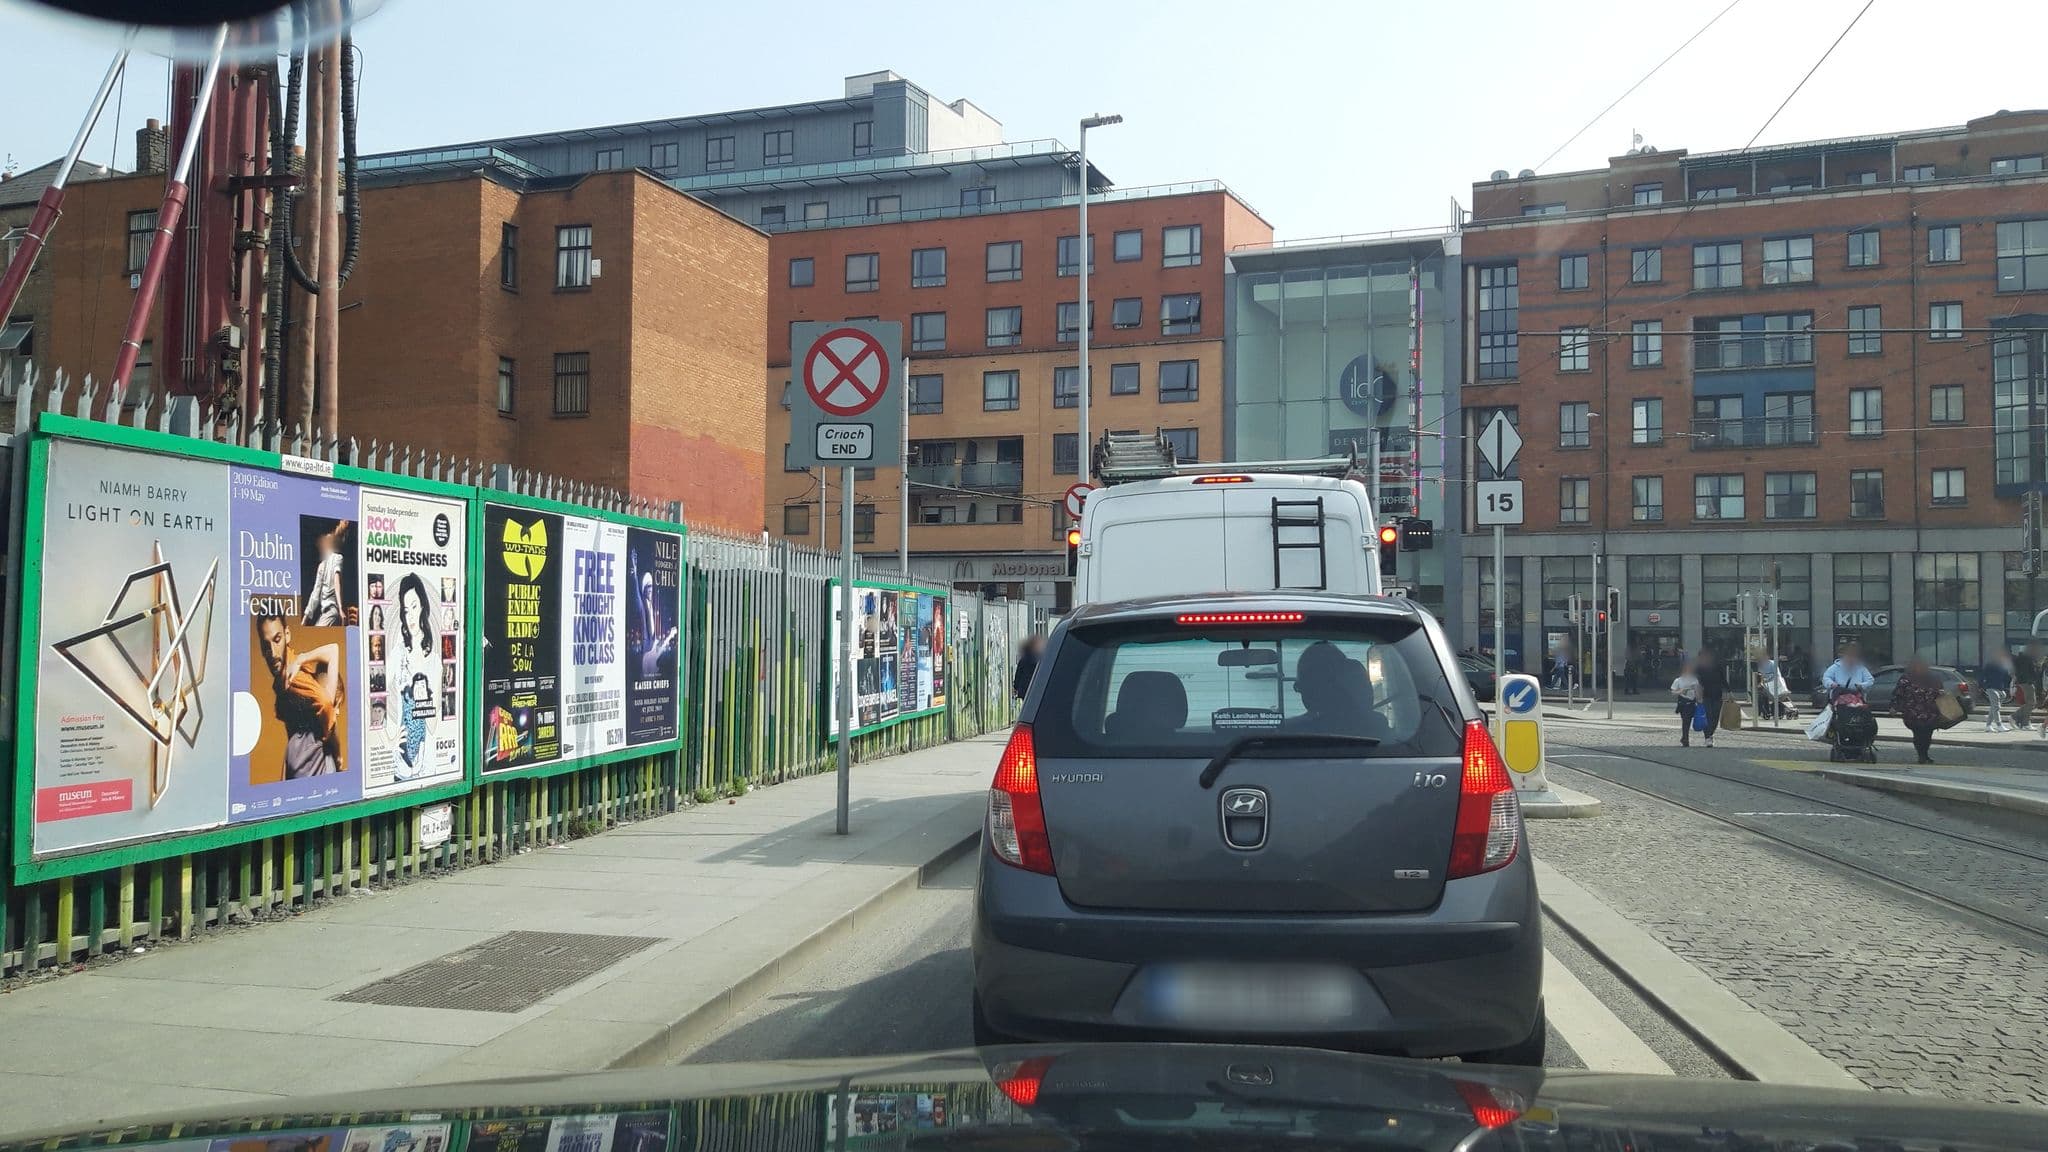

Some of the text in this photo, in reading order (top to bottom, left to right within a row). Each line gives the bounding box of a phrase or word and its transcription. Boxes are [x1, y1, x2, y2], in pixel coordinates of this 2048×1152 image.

[825, 429, 864, 440] Crioch
[832, 444, 857, 454] END
[285, 459, 331, 473] www.ipa-ltd.ie
[233, 472, 279, 490] 2019 Edition
[100, 480, 188, 502] NIAMH BARRY
[233, 488, 266, 504] 1-19 May
[367, 504, 419, 517] Sunday Independent
[1487, 493, 1513, 512] 15
[68, 503, 214, 531] LIGHT ON EARTH
[367, 515, 397, 532] ROCK
[240, 530, 293, 560] Dublin
[367, 531, 413, 548] AGAINST
[367, 547, 448, 567] HOMELESSNESS
[655, 541, 678, 560] NILE
[240, 559, 292, 588] Dance
[573, 549, 615, 594] FREE
[992, 562, 1065, 576] McDonal
[655, 569, 677, 587] CHIC
[508, 583, 541, 600] PUBLIC
[240, 588, 299, 616] Festival
[508, 600, 541, 615] ENEMY
[573, 593, 615, 615] THOUGHT
[1838, 612, 1888, 626] KING
[507, 623, 540, 638] RADIO
[573, 616, 615, 643] KNOWS
[511, 643, 535, 657] DE LA
[573, 643, 615, 666] NO CLASS
[512, 659, 533, 672] SOUL
[653, 679, 670, 689] CHIEFS
[61, 714, 91, 723] Admission
[61, 723, 104, 732] www.museum.ie
[436, 739, 456, 750] FOCUS
[1052, 773, 1103, 782] HYUNDAI
[1413, 772, 1447, 789] i10
[59, 789, 92, 802] museum
